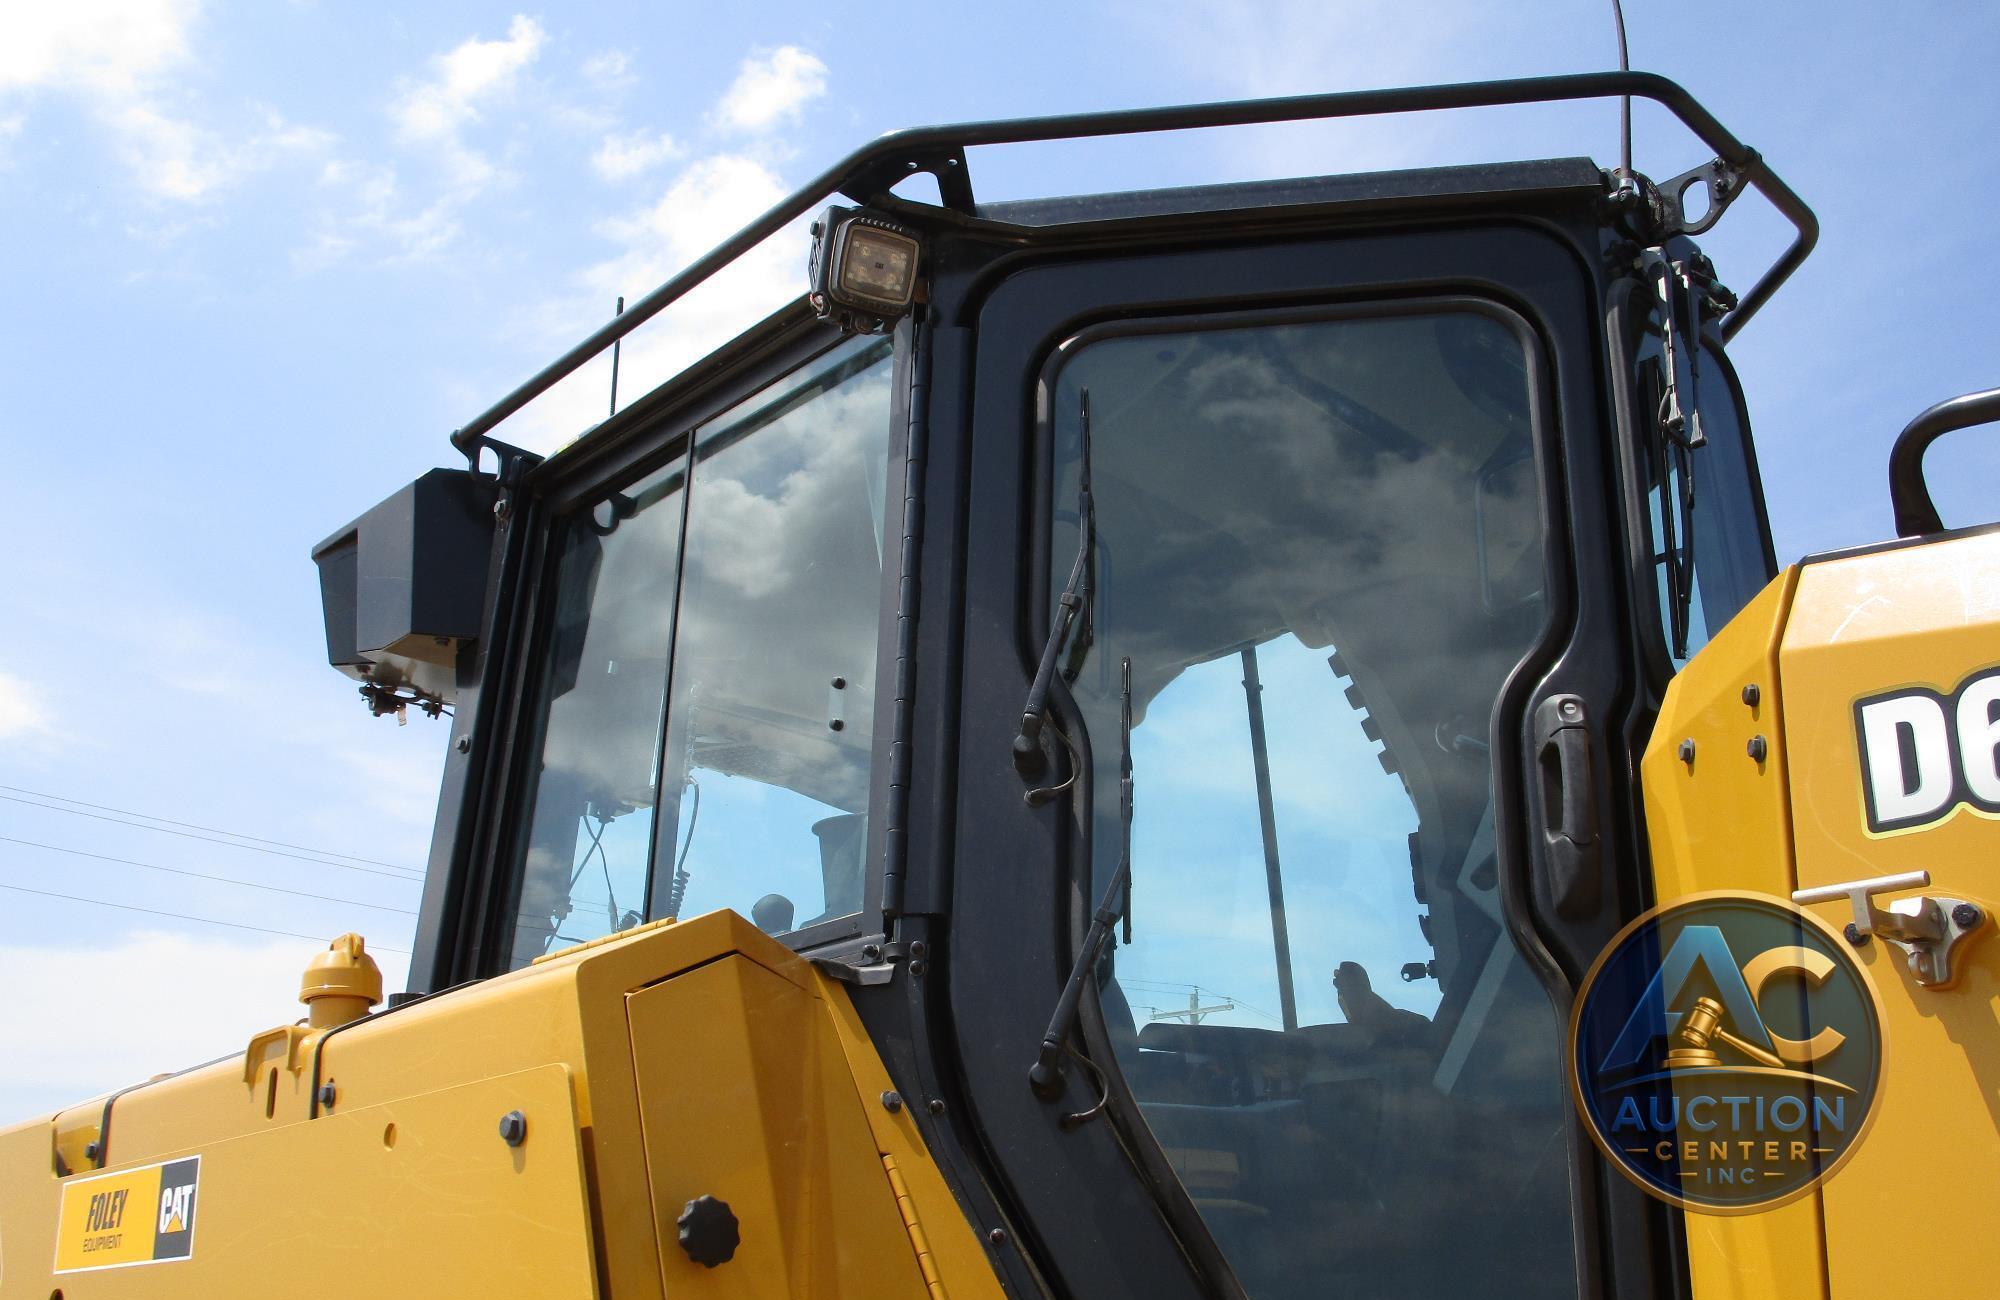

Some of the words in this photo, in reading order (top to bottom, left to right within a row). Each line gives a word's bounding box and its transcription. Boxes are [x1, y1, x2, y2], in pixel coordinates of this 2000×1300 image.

[86, 1188, 130, 1232] FOLEY
[159, 1184, 193, 1233] CAT
[83, 1233, 123, 1252] EQUIPMENT
